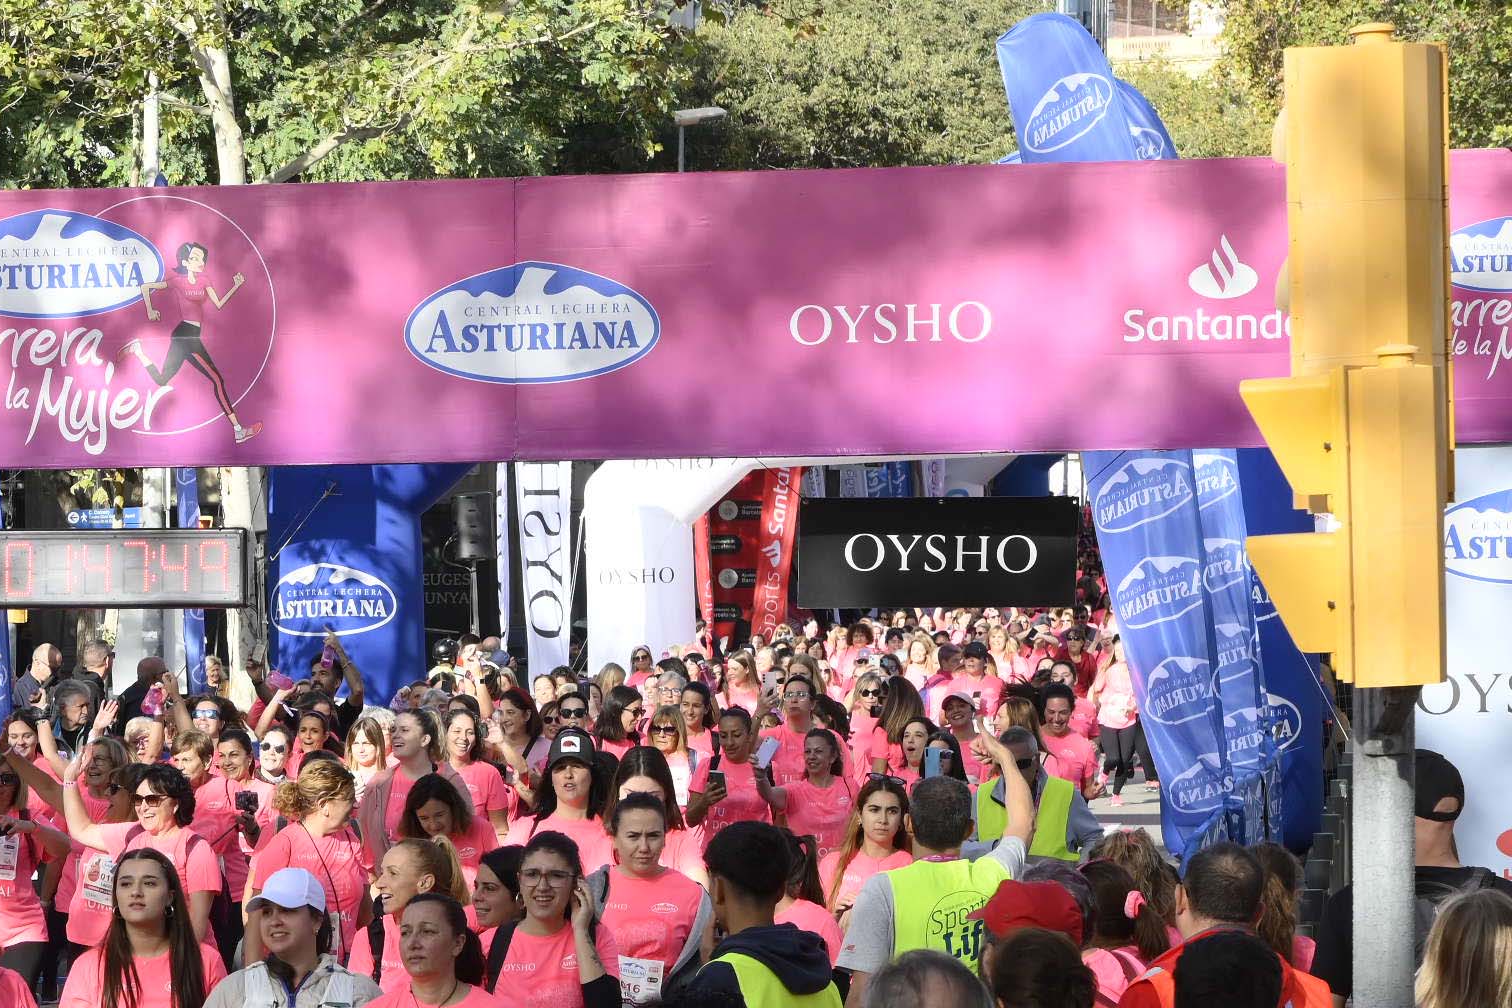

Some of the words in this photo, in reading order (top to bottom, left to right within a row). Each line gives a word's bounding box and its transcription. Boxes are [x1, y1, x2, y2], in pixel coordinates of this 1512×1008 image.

[425, 309, 640, 354] ASTURIANA
[788, 301, 992, 346] OYSHO
[5, 370, 30, 410] la
[25, 361, 174, 455] Mujer
[5, 541, 230, 597] 01:47:49
[844, 533, 1038, 574] OYSHO
[287, 588, 329, 597] CENTRAL
[334, 588, 383, 597] LECHERA
[599, 566, 675, 585] OYSHO
[275, 593, 388, 621] ASTURIANA
[503, 962, 536, 972] OYSHO
